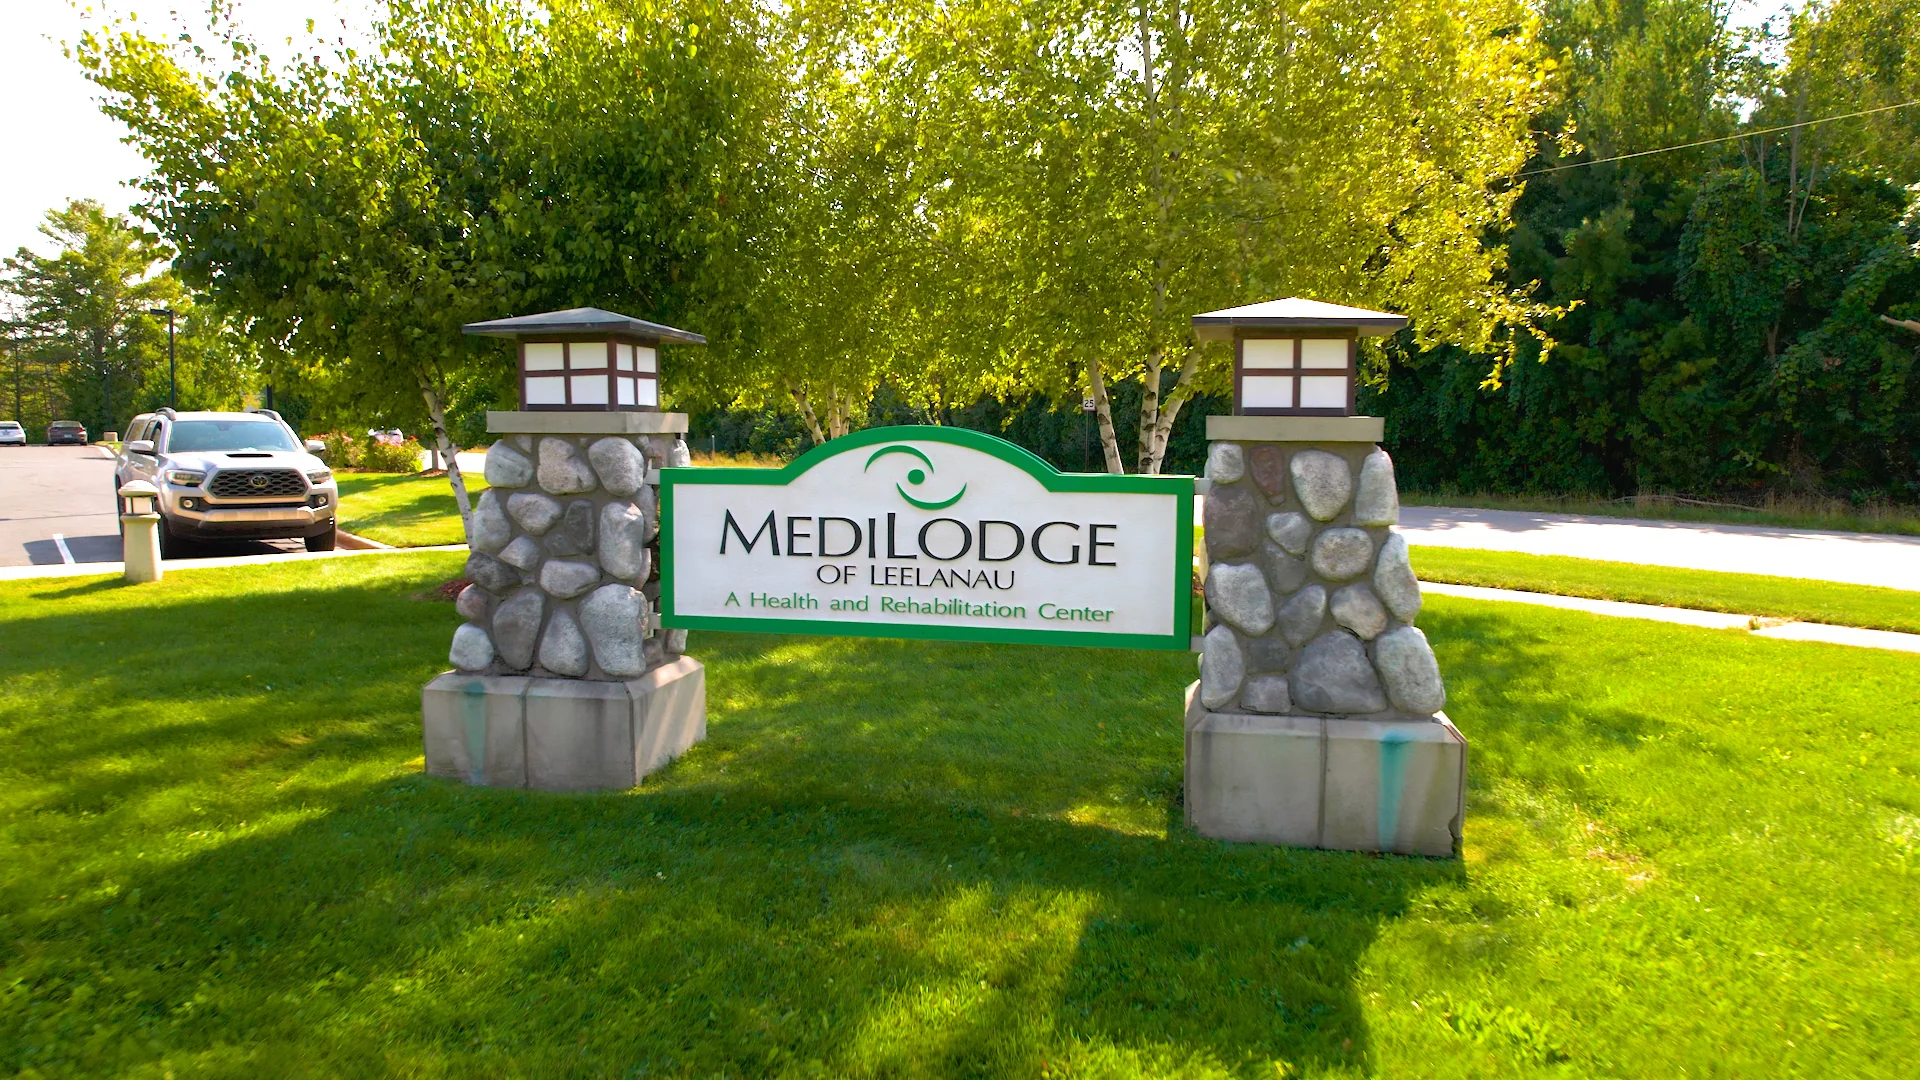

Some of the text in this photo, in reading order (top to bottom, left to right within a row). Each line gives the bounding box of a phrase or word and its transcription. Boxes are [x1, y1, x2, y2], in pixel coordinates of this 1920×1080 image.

[1084, 399, 1094, 408] 25
[816, 564, 1015, 591] OF LEELANAU
[724, 591, 1114, 623] A Health and Rehabilitation Center
